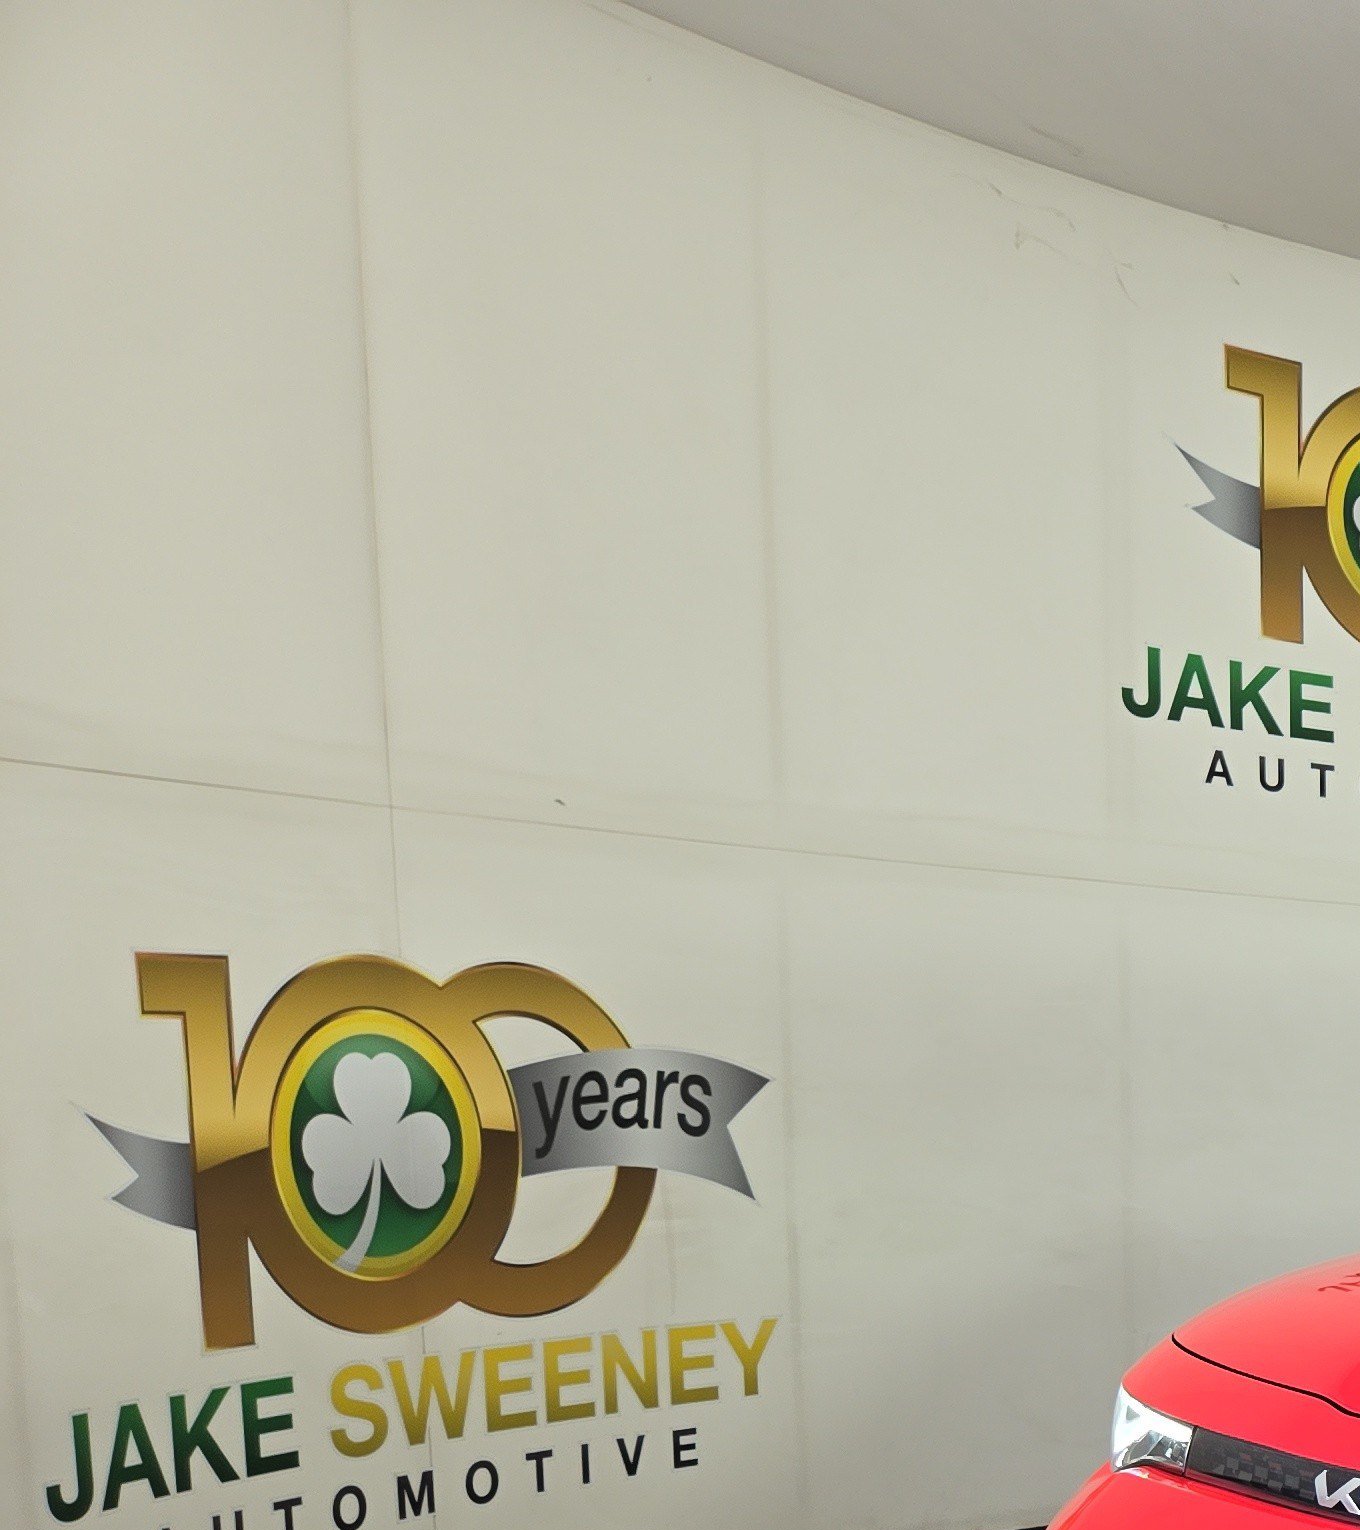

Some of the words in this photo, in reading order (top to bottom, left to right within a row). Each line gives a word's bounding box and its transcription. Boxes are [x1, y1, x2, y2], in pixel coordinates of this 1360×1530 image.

[1120, 645, 1336, 744] JAKE
[135, 952, 659, 1352] 100
[533, 1067, 713, 1160] years
[45, 1375, 302, 1524] JAKE
[328, 1317, 779, 1459] SWEENEY
